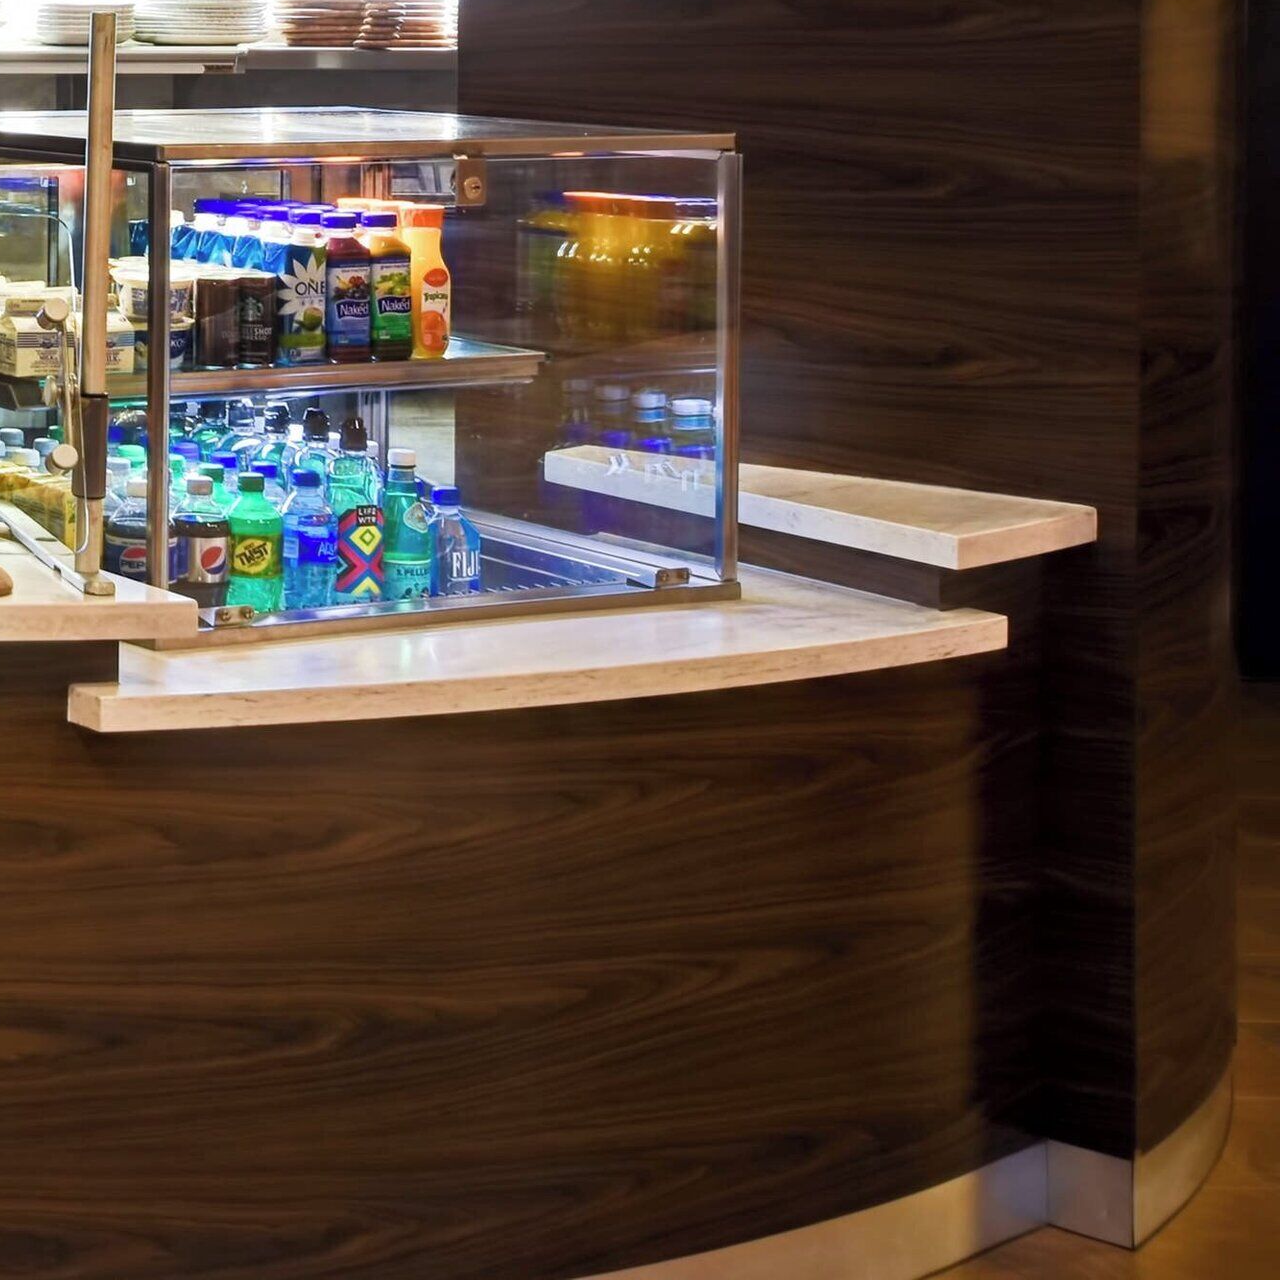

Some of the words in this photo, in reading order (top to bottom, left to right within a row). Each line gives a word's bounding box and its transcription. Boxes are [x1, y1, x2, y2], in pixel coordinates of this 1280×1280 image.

[340, 303, 370, 316] Naked
[381, 297, 411, 311] Naked
[358, 507, 377, 516] LIFE
[358, 515, 377, 524] WTR
